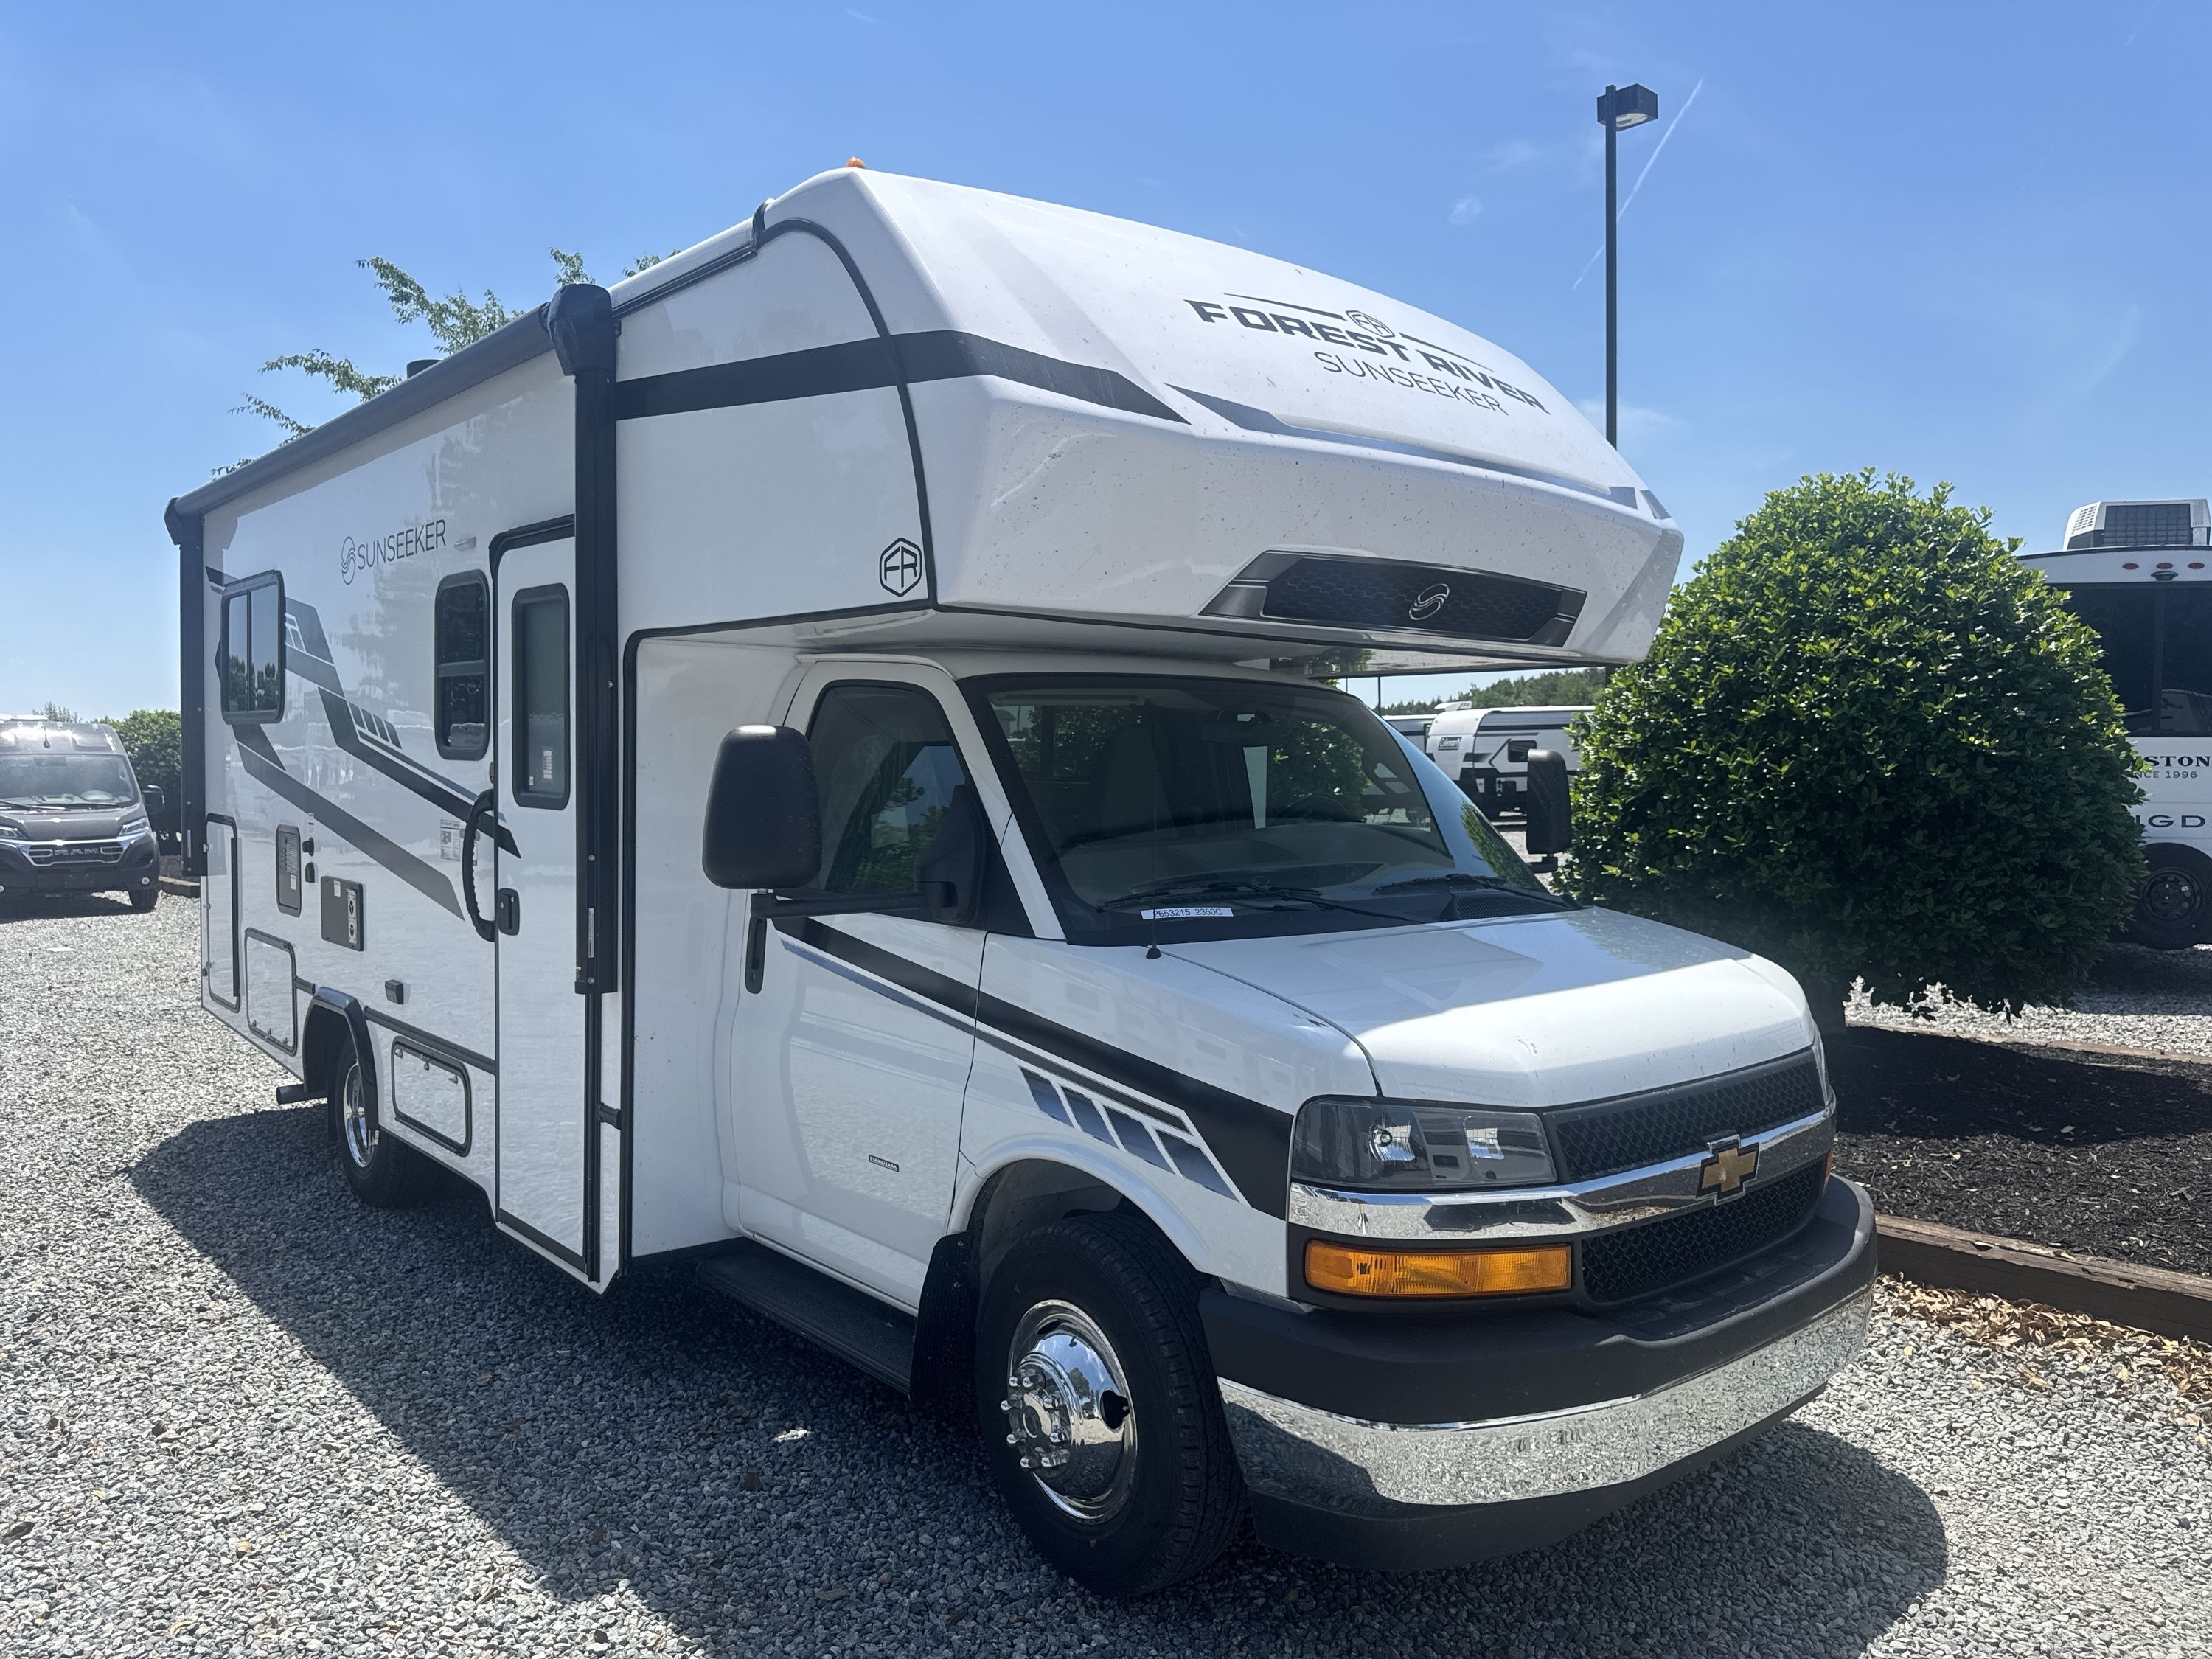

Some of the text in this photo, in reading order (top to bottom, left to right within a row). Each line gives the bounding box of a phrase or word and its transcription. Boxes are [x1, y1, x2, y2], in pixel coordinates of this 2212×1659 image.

[1183, 299, 1551, 416] FOREST RIVER
[1314, 351, 1509, 417] SUNSEEKER
[358, 518, 446, 571] SUNSEEKER
[2135, 755, 2211, 768] STON
[2165, 771, 2197, 779] 1996
[54, 848, 99, 856] RAM
[1153, 908, 1222, 918] 2653215 2350C
